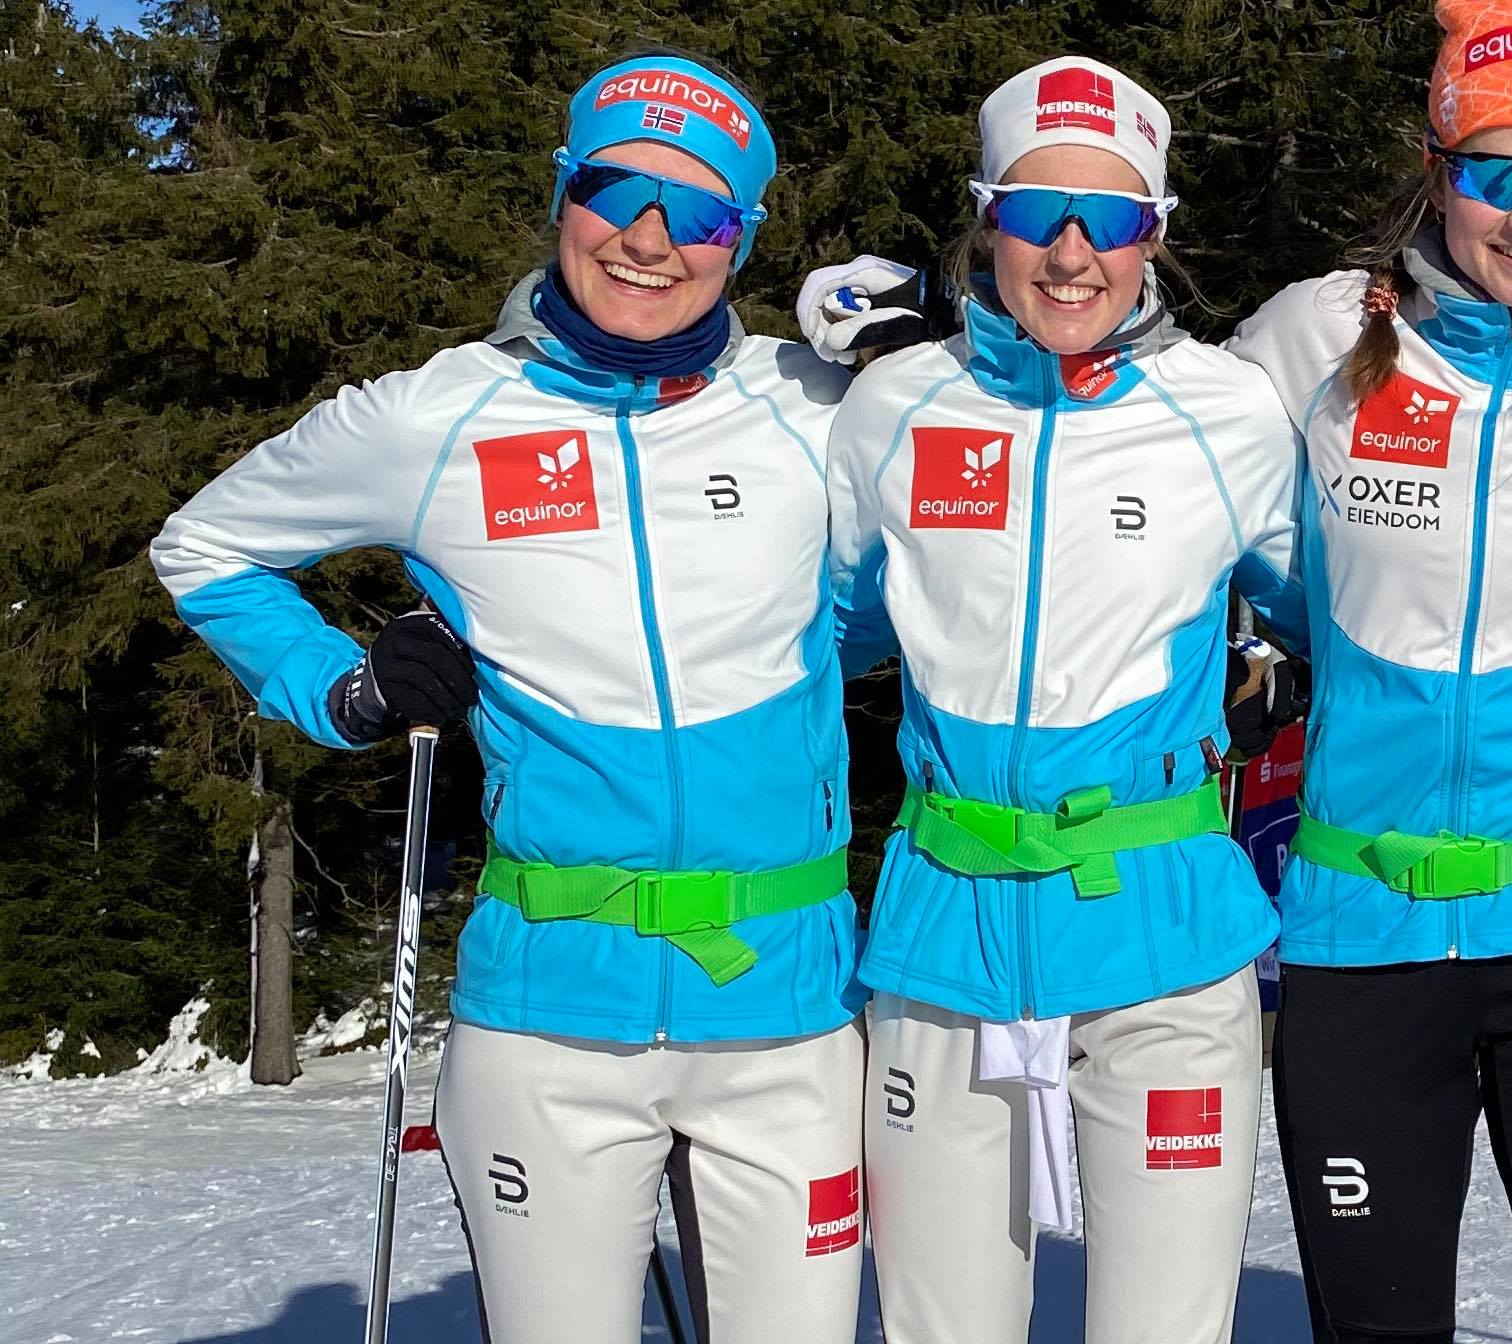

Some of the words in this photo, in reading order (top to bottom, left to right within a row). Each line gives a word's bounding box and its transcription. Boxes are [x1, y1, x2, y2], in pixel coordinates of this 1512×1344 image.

[600, 73, 727, 114] equinor
[1036, 101, 1118, 120] VEIDEKKE
[1360, 431, 1442, 453] equinor
[1349, 475, 1440, 508] OXER
[494, 499, 586, 527] equinor
[918, 496, 999, 519] equinor
[1347, 507, 1440, 530] EIENDOM
[1145, 1133, 1223, 1151] VEIDEKKE
